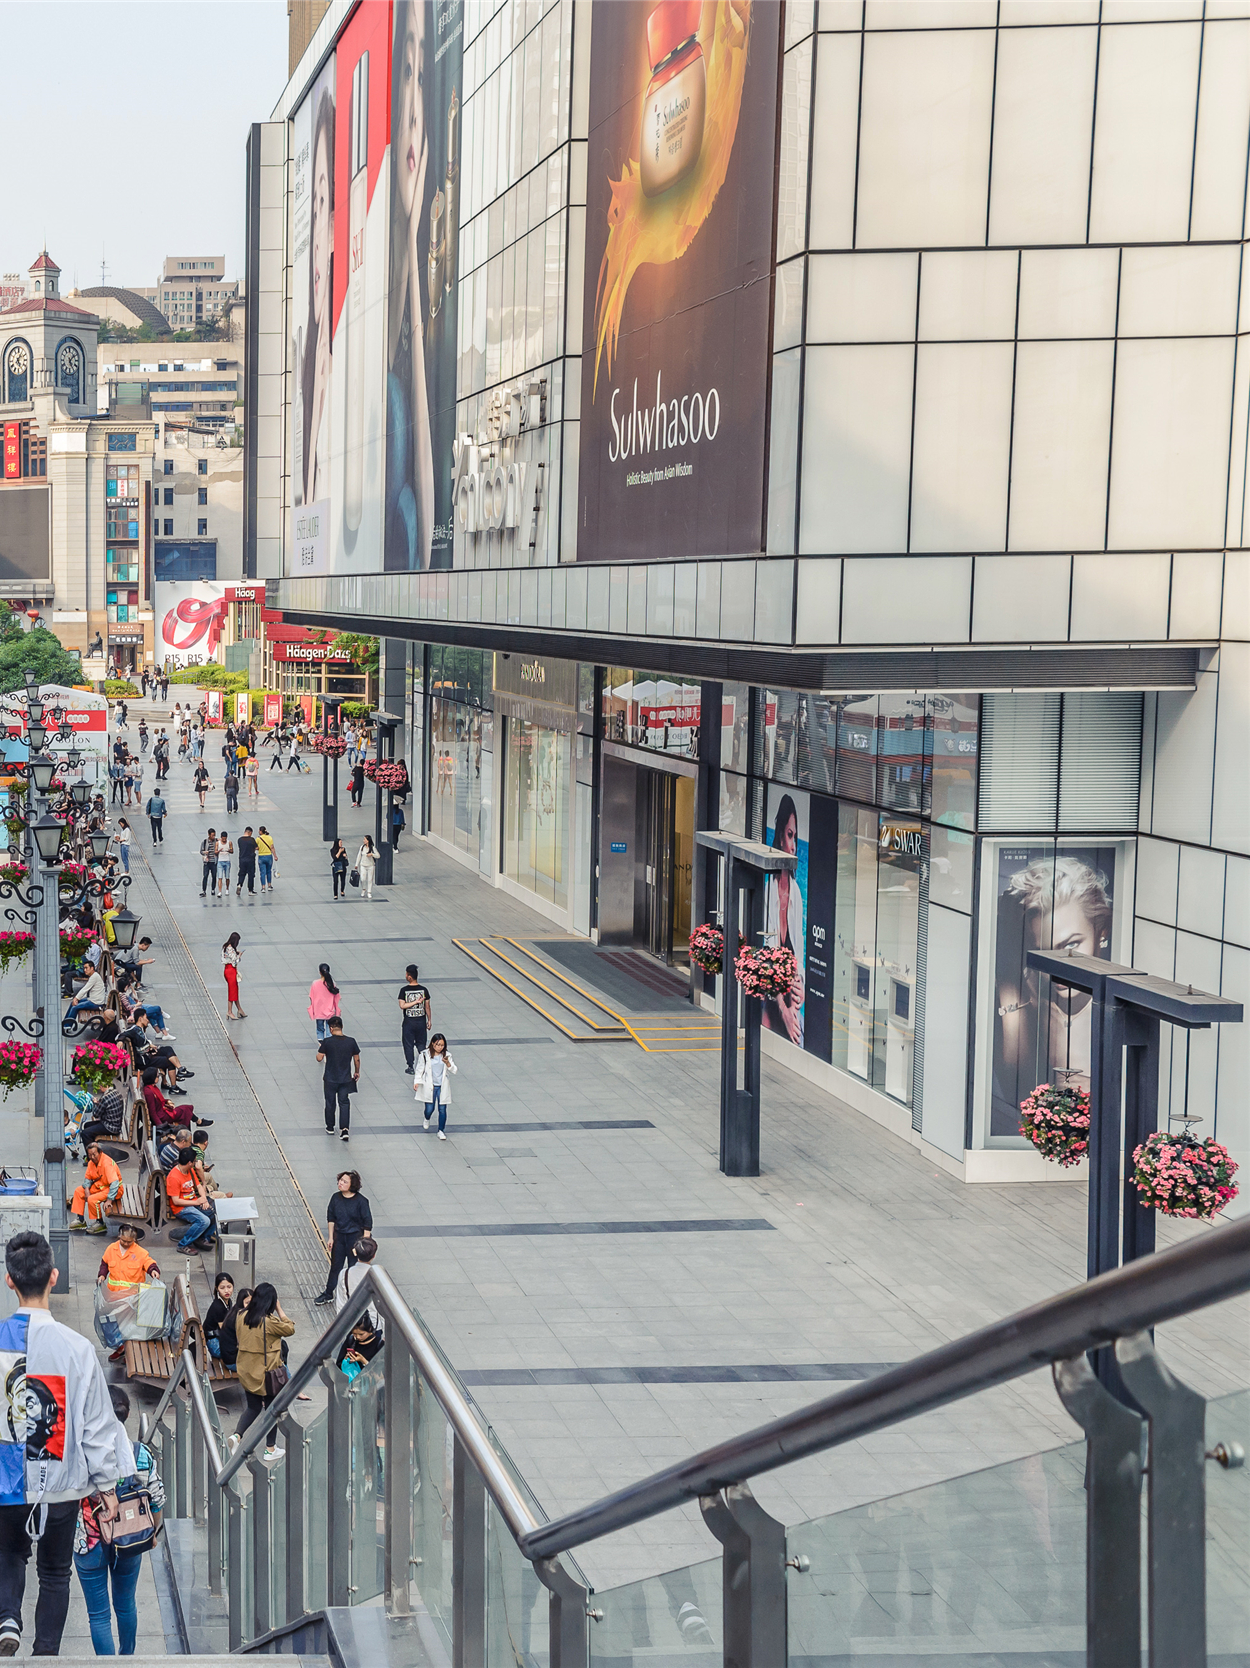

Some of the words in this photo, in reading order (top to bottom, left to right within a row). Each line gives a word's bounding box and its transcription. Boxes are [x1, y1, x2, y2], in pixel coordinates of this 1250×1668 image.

[608, 369, 721, 463] Sulwhasoo
[640, 470, 654, 486] Beauty
[654, 467, 663, 482] from
[675, 460, 693, 477] Wisdom
[894, 827, 922, 856] SWAR
[812, 924, 826, 942] apm
[39, 1465, 47, 1492] V/MADE
